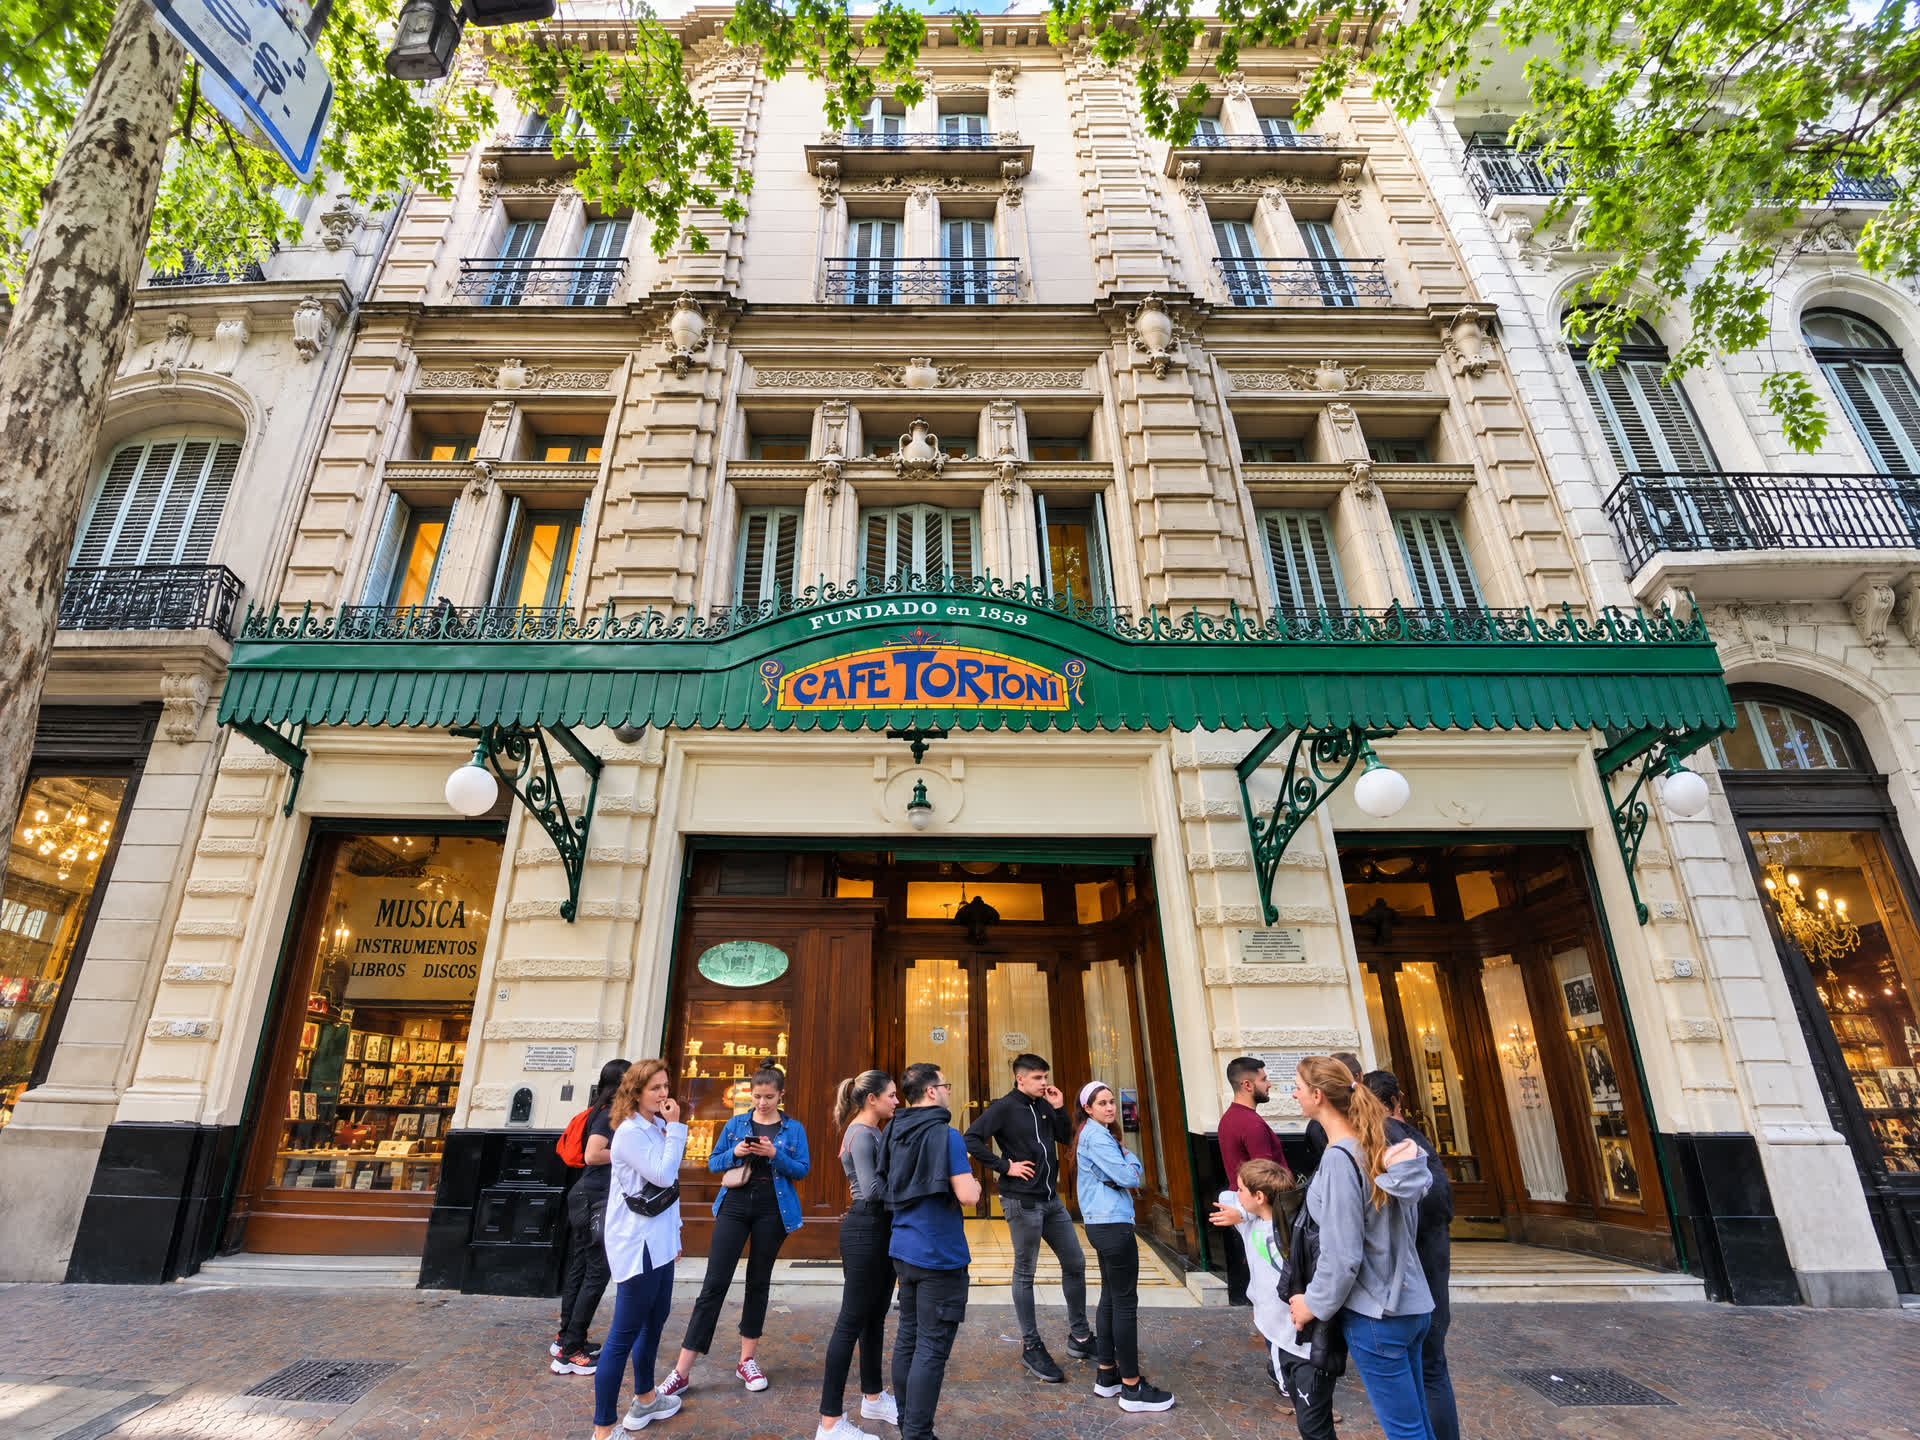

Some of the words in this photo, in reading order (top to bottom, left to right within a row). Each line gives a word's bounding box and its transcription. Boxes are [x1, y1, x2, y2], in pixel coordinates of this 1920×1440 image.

[808, 601, 938, 630] FUNDADO
[946, 605, 971, 617] en
[978, 606, 1028, 626] 1858
[374, 898, 466, 928] MUSICA
[355, 938, 478, 955] INSTRUMENTOS
[351, 962, 406, 977] LIBROS
[422, 963, 477, 978] DISCOS
